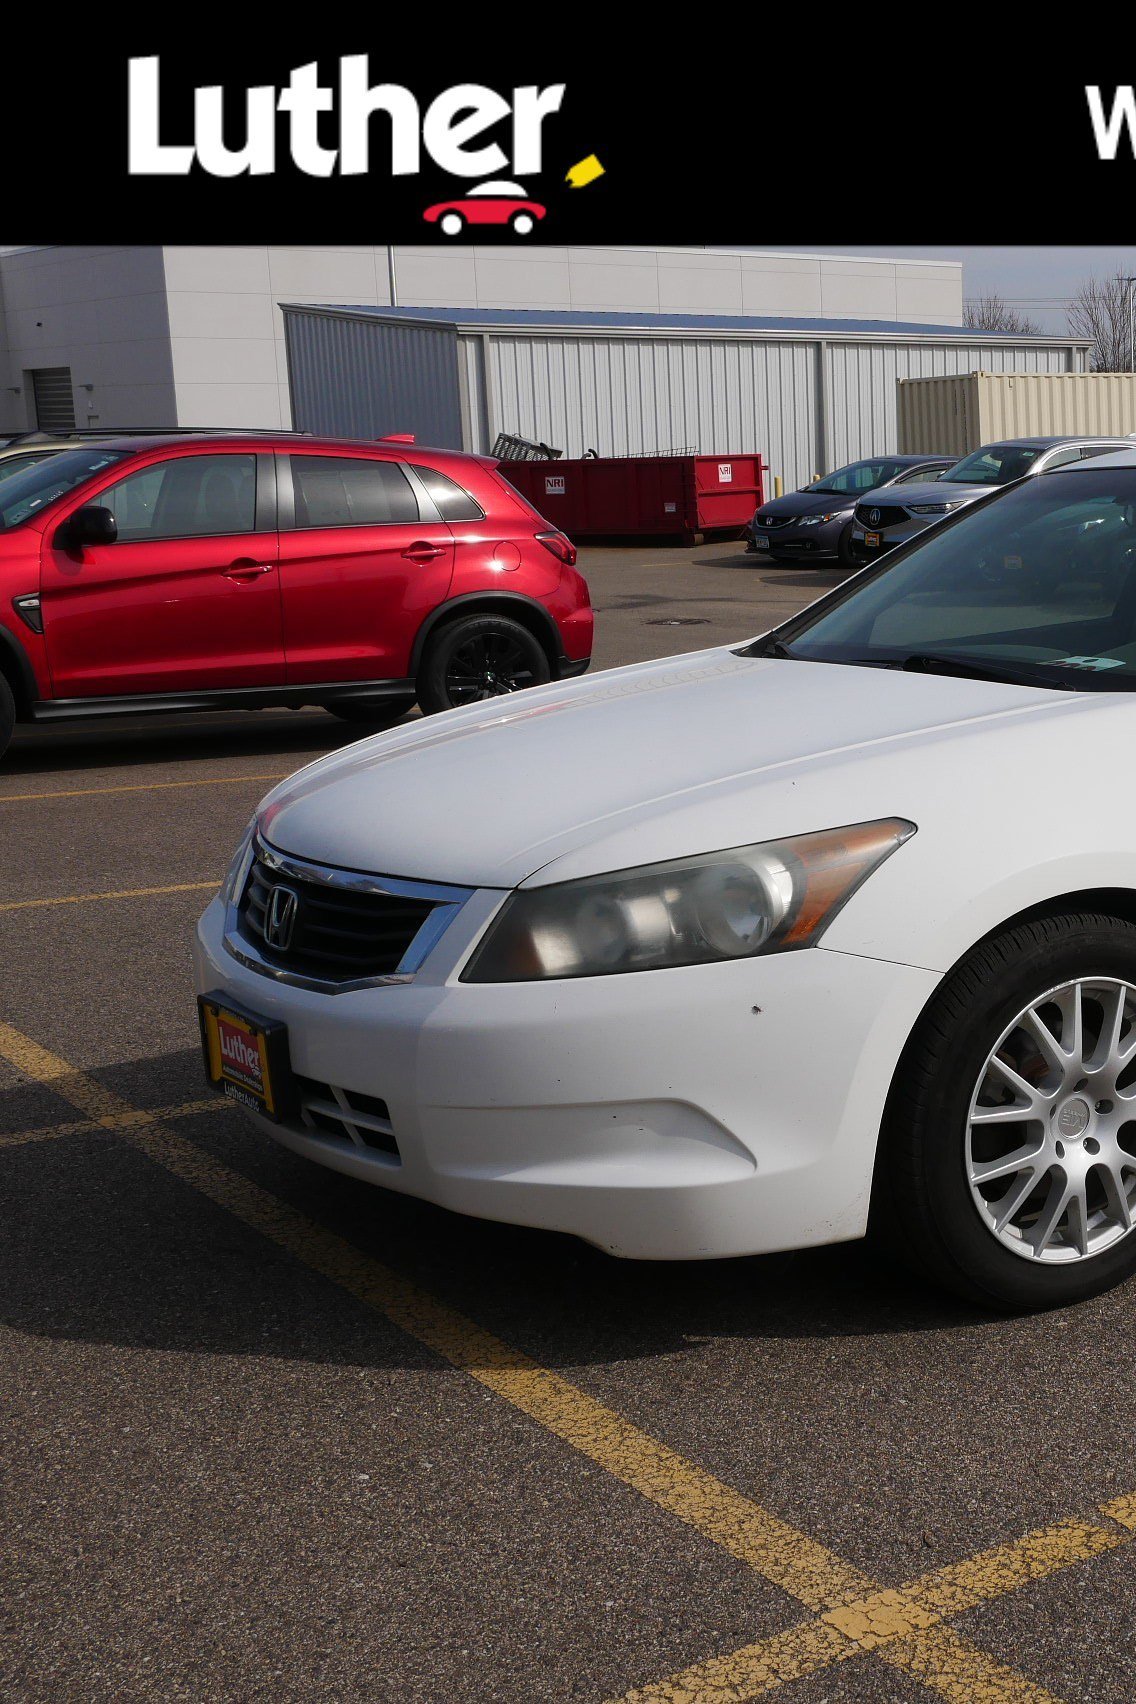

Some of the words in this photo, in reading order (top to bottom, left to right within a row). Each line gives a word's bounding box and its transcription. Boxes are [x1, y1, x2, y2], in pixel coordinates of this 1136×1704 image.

[719, 466, 731, 475] NRI
[546, 478, 564, 488] NRI
[219, 1026, 259, 1068] Luther
